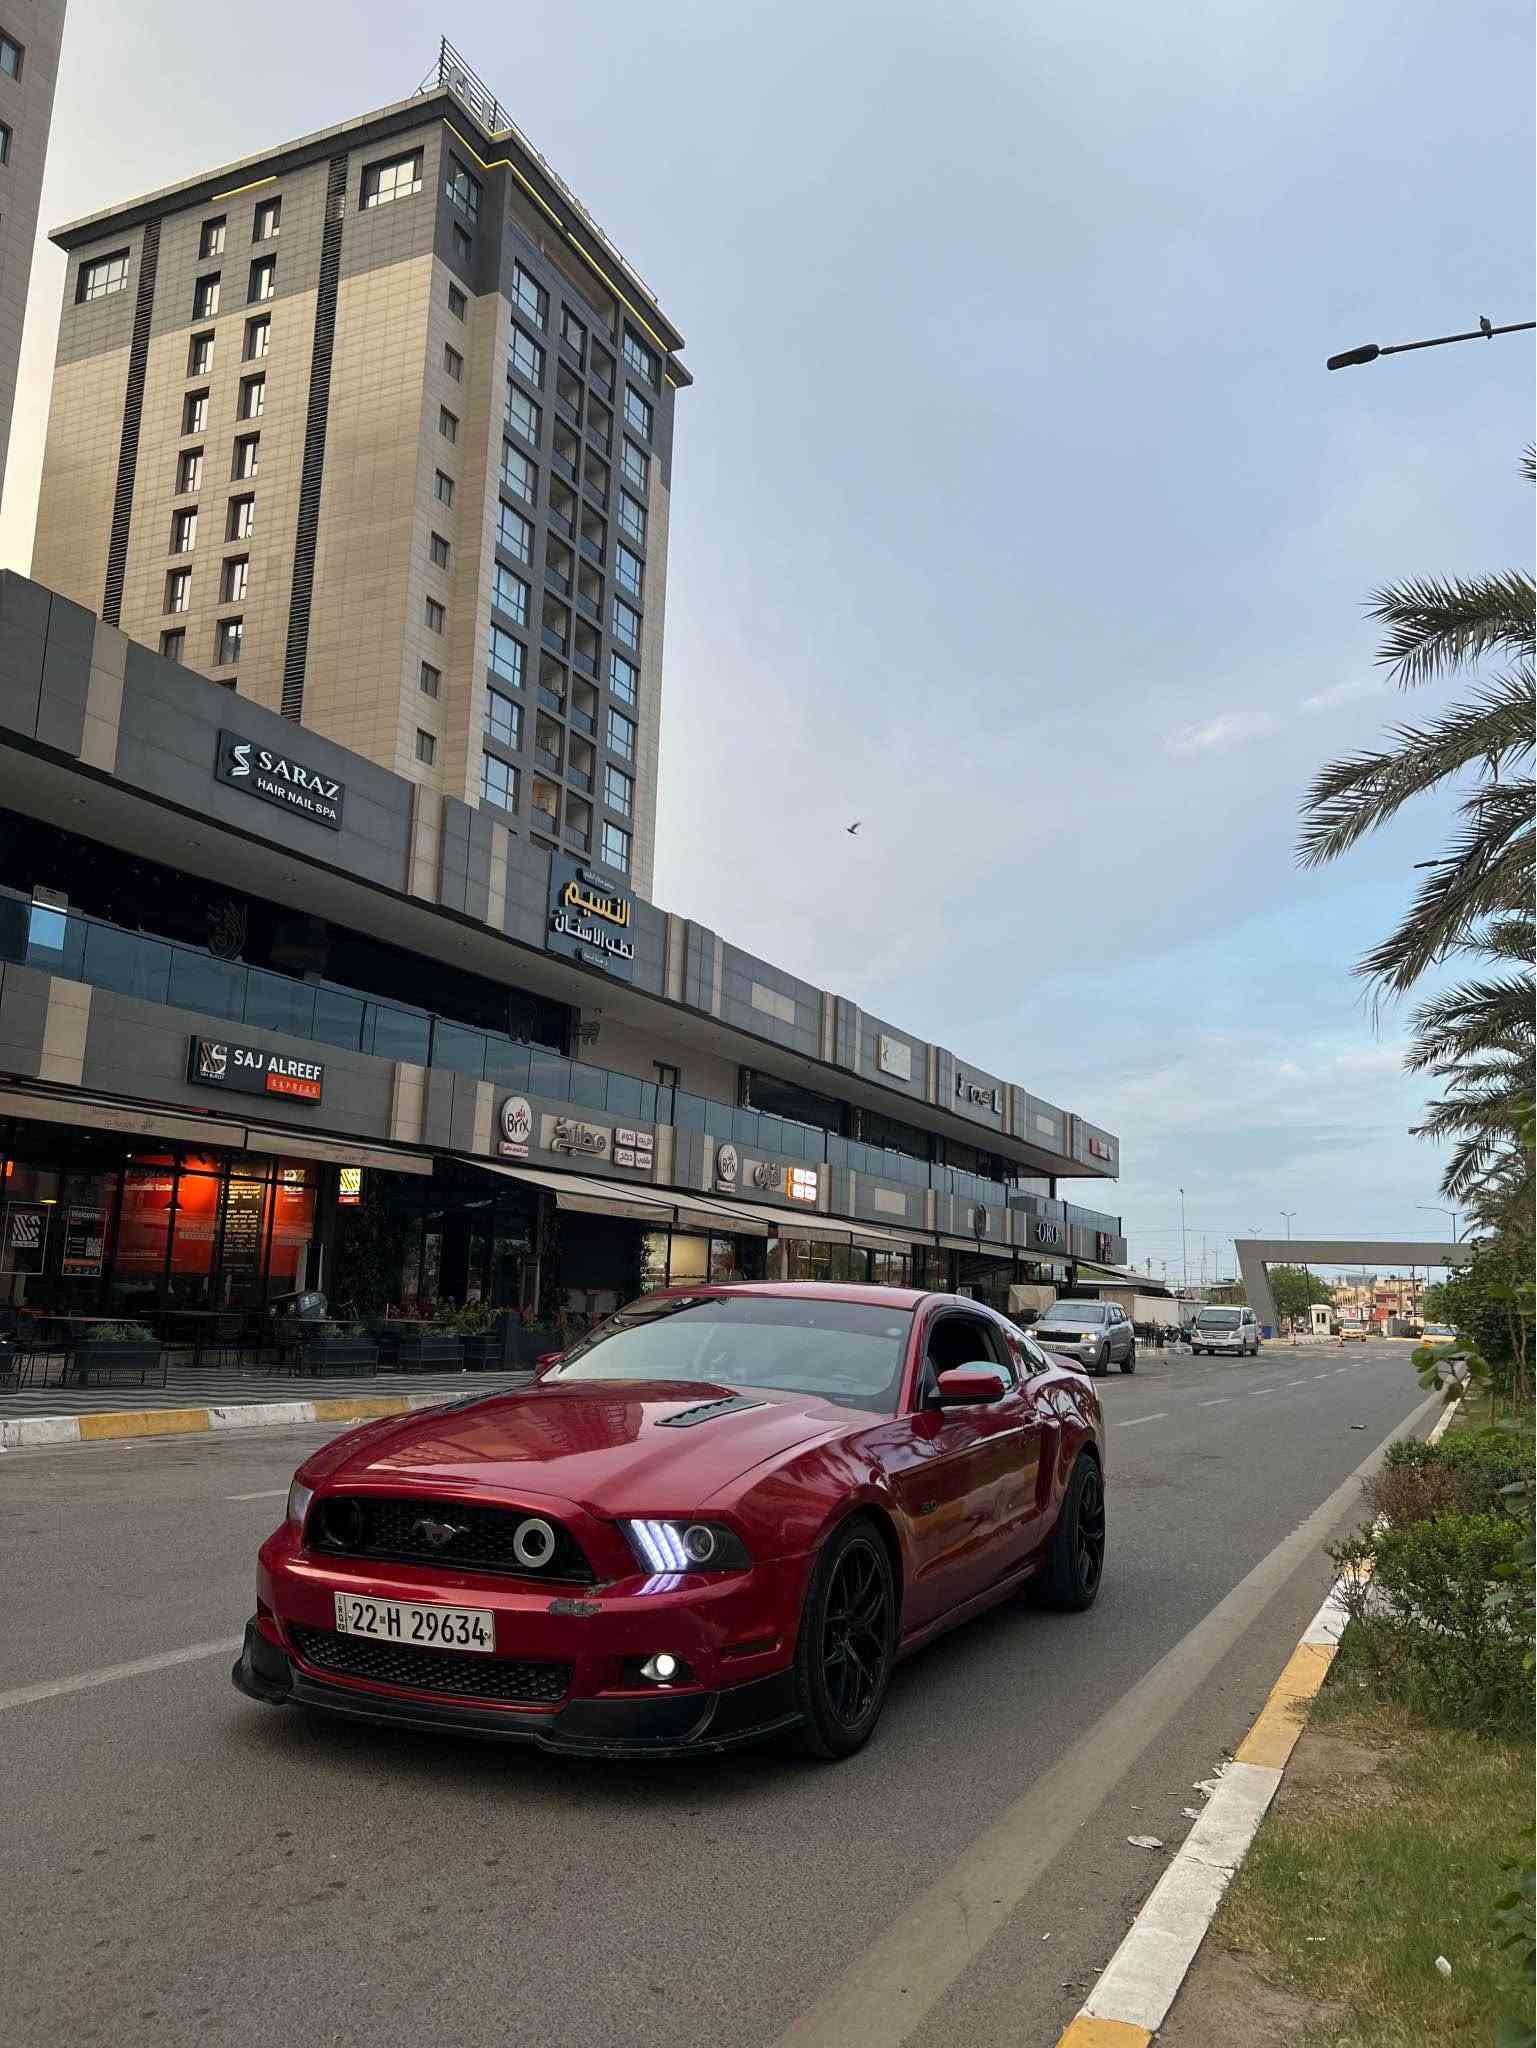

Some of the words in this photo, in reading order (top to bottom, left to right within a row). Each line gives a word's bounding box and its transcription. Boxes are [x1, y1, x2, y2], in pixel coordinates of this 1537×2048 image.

[260, 751, 339, 801] SARAZ
[258, 777, 286, 799] HAIR
[288, 791, 314, 811] NAIL
[315, 803, 337, 820] SPA
[564, 880, 630, 928] النسيم
[605, 937, 635, 959] لطب
[234, 1048, 263, 1069] SAJ
[267, 1056, 322, 1081] ALREEF
[411, 1610, 486, 1646] 29634
